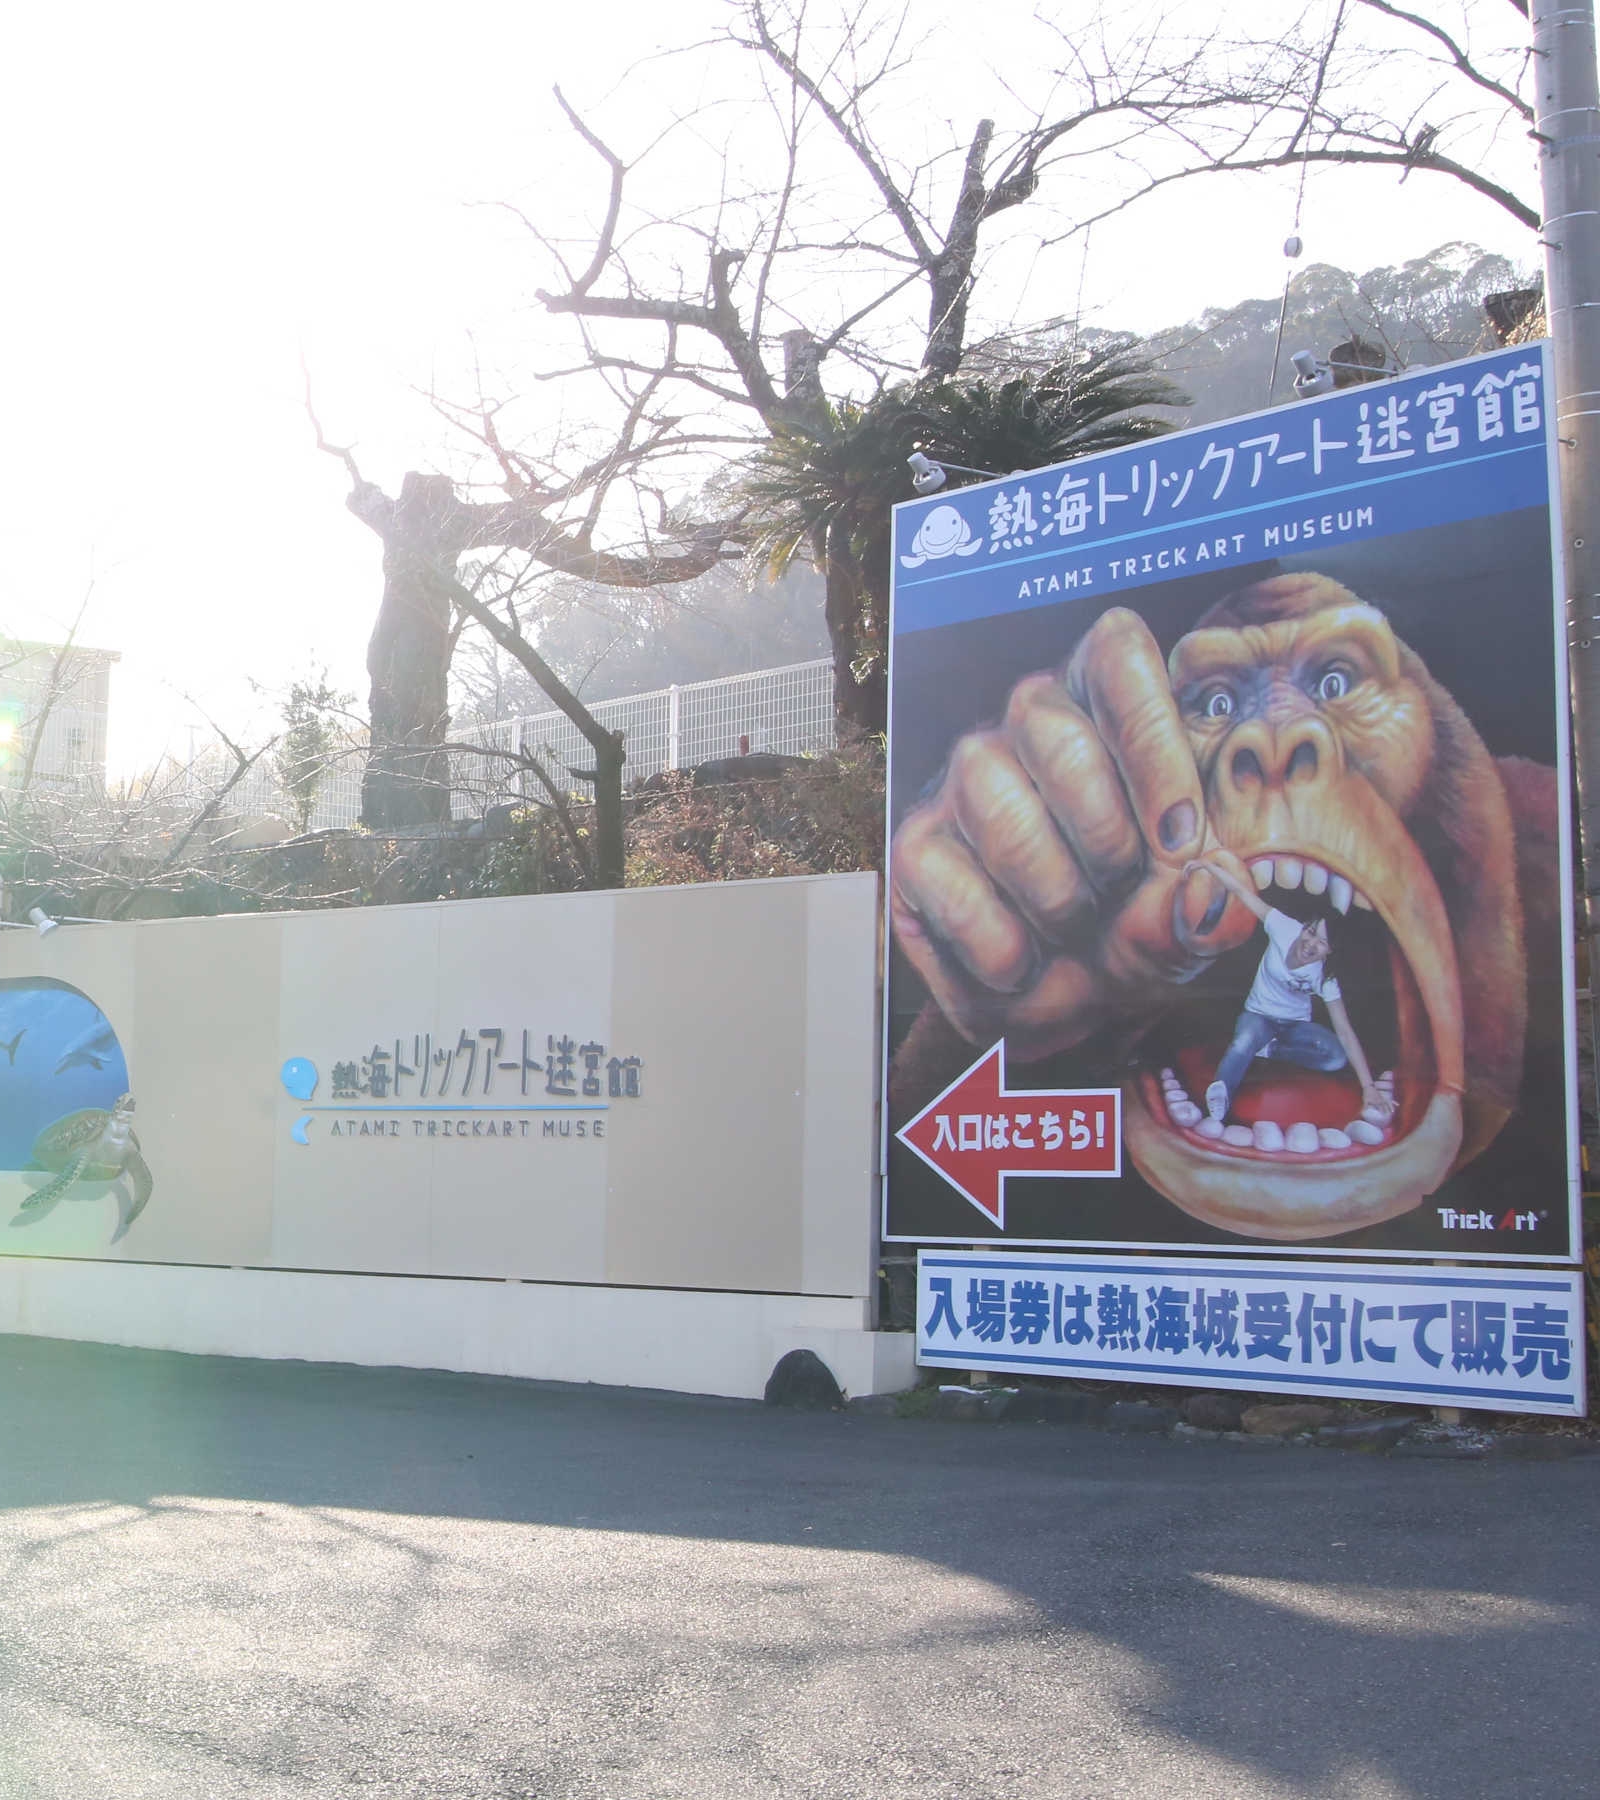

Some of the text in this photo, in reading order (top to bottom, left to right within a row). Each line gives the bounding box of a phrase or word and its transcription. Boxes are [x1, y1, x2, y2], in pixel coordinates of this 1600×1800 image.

[988, 361, 1541, 555] 熱海トリックアート迷宮館
[1018, 566, 1094, 599] ATAMI
[1264, 506, 1374, 545] MUSEUM
[331, 1028, 643, 1099] 熱海トリックアート迷宮館
[331, 1119, 606, 1138] ATAMI TRICKART MUSE
[931, 1110, 1105, 1152] 入口はこちら!
[1437, 1208, 1495, 1230] Trick
[924, 1276, 1571, 1381] 入場券は熱海城受付にて販売
